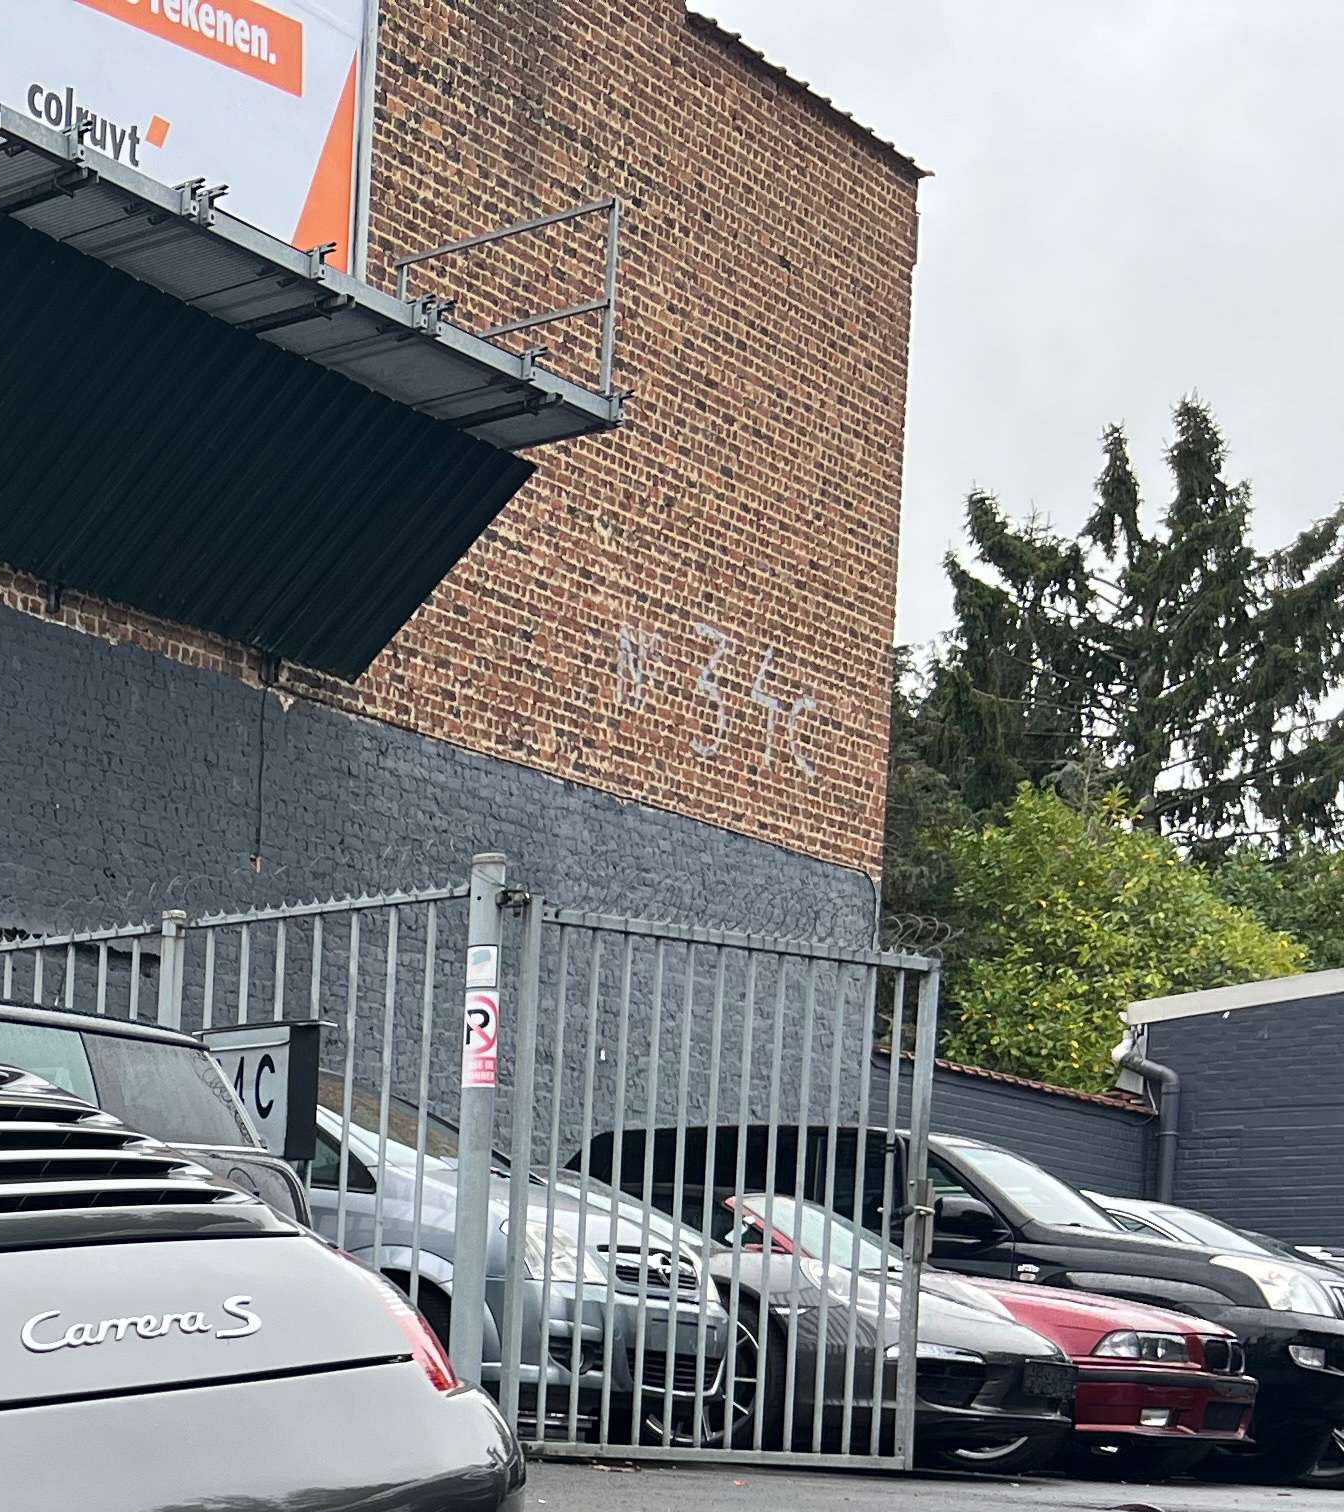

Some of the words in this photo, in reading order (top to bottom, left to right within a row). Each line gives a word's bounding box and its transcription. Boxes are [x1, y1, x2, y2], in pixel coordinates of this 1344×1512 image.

[26, 83, 141, 168] colruyt
[20, 1310, 213, 1353] Carrera
[215, 1295, 263, 1339] S
